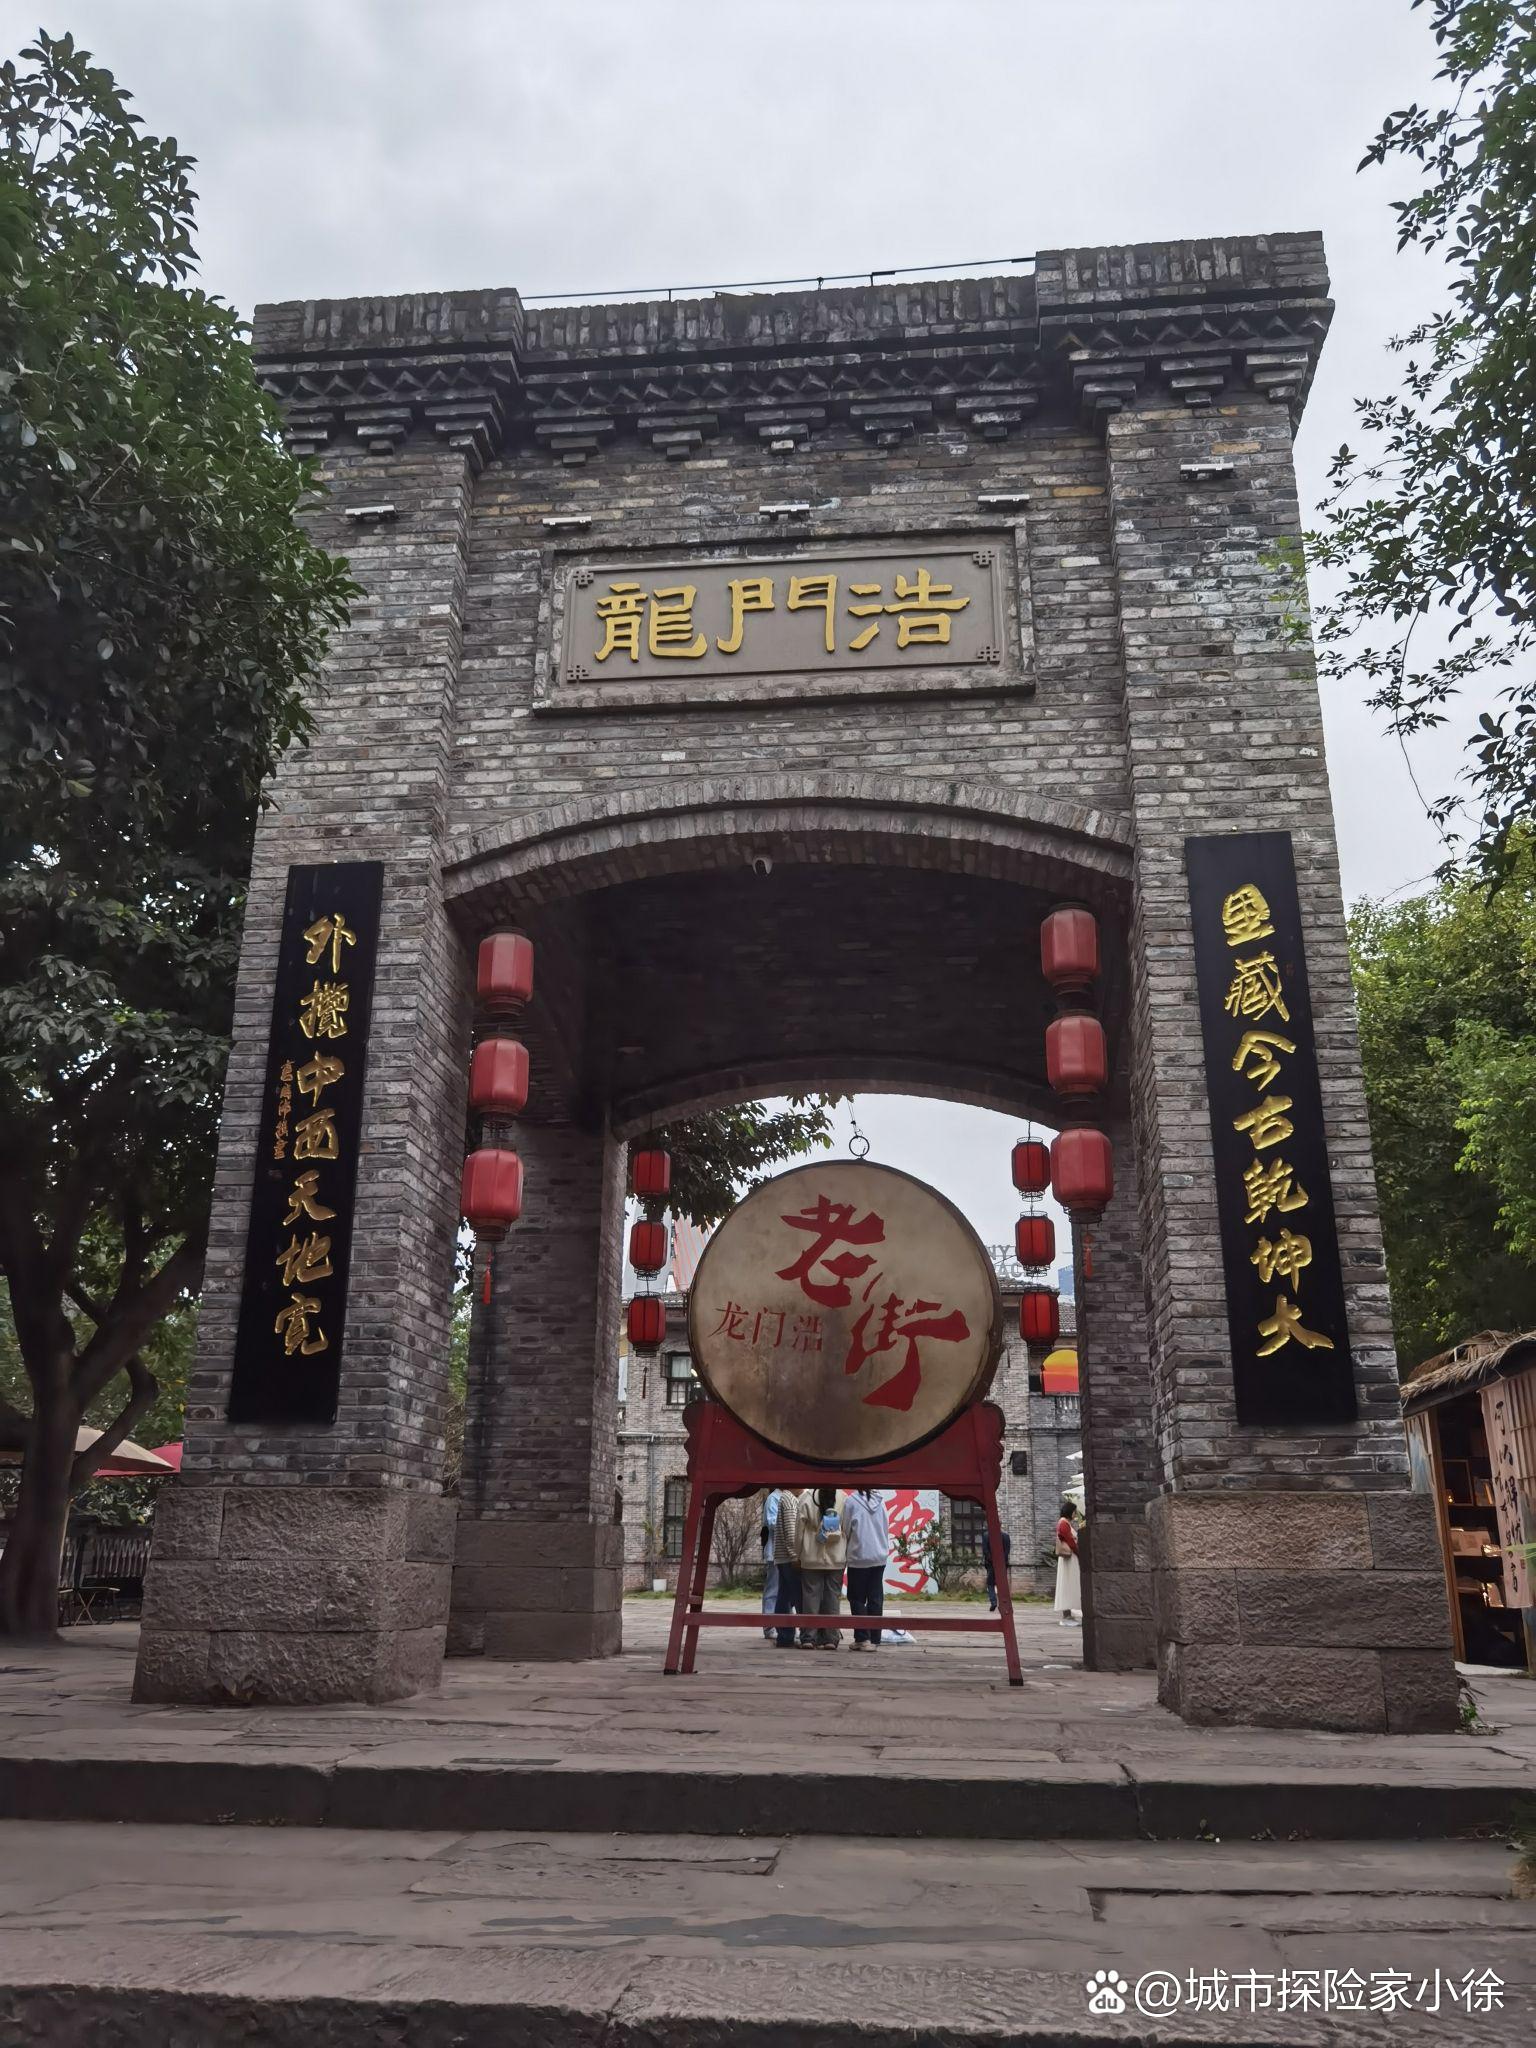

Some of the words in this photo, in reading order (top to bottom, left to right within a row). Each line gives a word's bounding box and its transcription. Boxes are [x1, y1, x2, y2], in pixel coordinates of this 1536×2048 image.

[595, 568, 971, 662] 龍門浩
[775, 1194, 971, 1412] 老街
